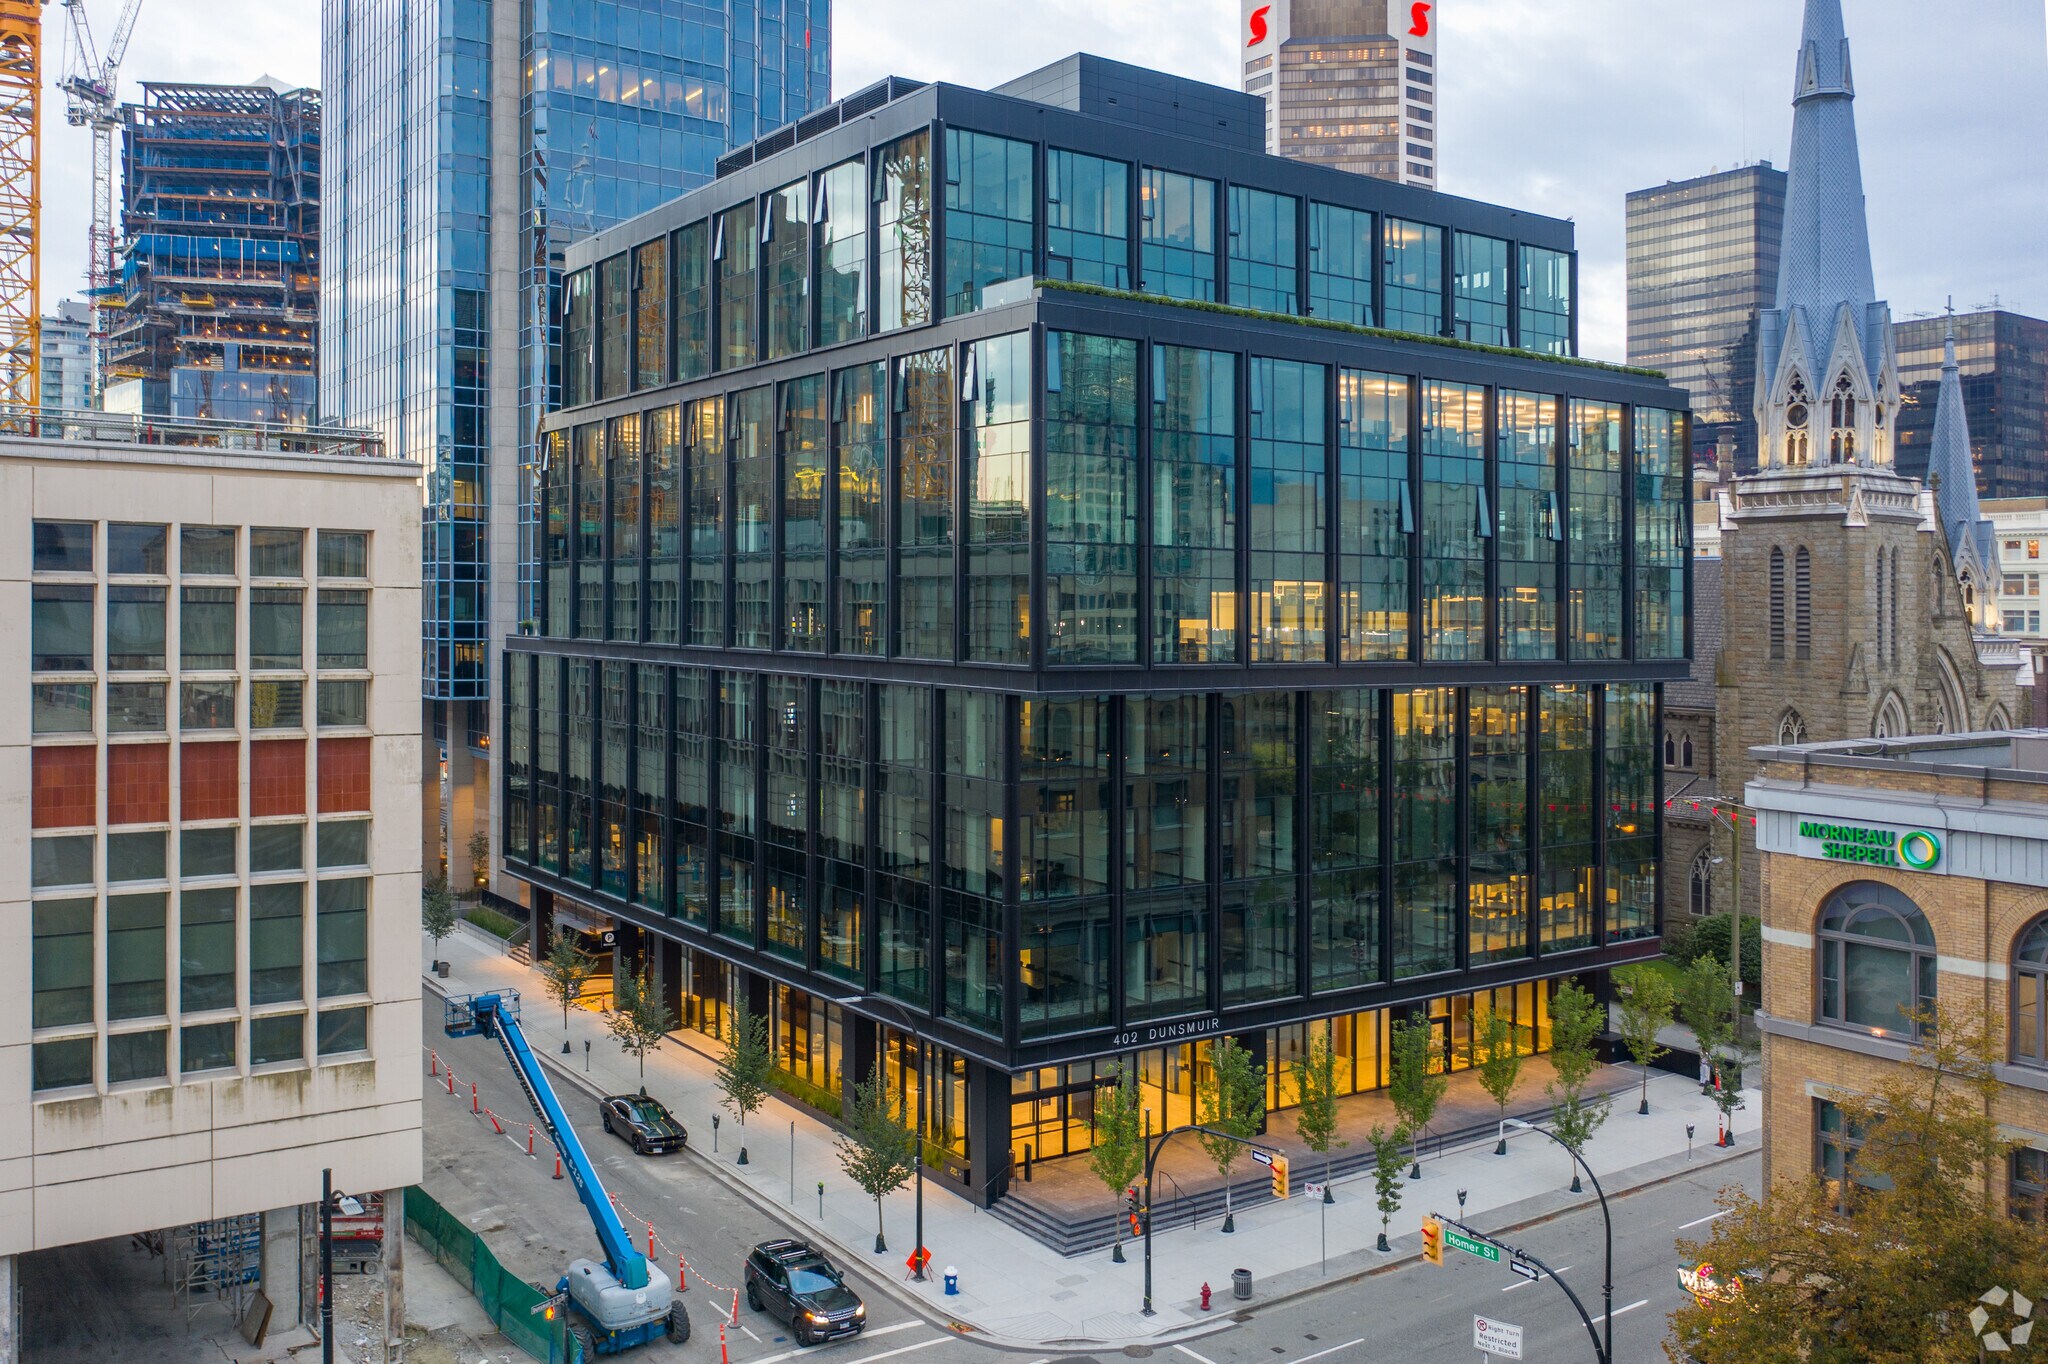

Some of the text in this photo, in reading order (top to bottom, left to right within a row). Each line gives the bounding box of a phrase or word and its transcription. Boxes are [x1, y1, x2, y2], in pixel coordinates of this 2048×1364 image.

[1799, 821, 1895, 847] MORNEAU
[1821, 841, 1900, 867] SHEPELL
[1113, 1017, 1219, 1046] 402 DUNSMUIR
[1448, 1233, 1495, 1259] Homer St
[1479, 1332, 1517, 1348] Restricted
[1488, 1324, 1520, 1337] Right Turn
